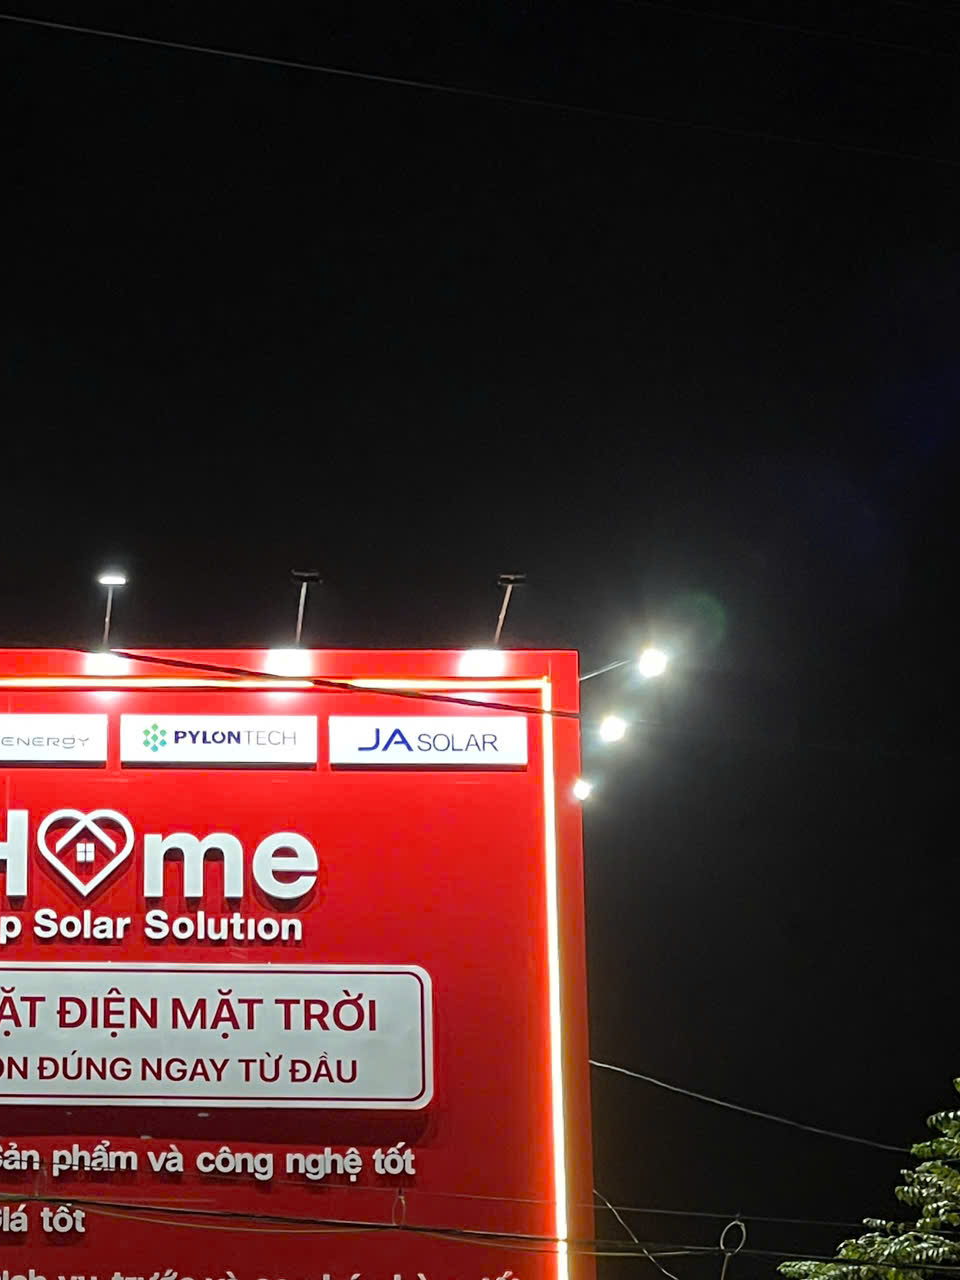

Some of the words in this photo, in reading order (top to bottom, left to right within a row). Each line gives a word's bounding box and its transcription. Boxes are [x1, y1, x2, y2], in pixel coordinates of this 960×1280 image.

[358, 728, 413, 752] JA
[417, 733, 499, 752] SOLAR
[33, 908, 131, 940] Solar
[144, 909, 303, 941] Solution
[56, 987, 158, 1038] ĐIỆN
[171, 988, 264, 1039] MẶT
[274, 989, 377, 1031] TRỜI
[37, 1050, 132, 1081] ĐÚNG
[140, 1057, 230, 1082] NGAY
[238, 1051, 283, 1083] TỪ
[289, 1051, 358, 1083] ĐẦU
[52, 1140, 138, 1177] phẩm
[147, 1145, 184, 1173] và
[196, 1146, 274, 1181] công
[286, 1147, 362, 1182] nghệ
[372, 1142, 416, 1175] tốt
[40, 1203, 86, 1233] tốt
